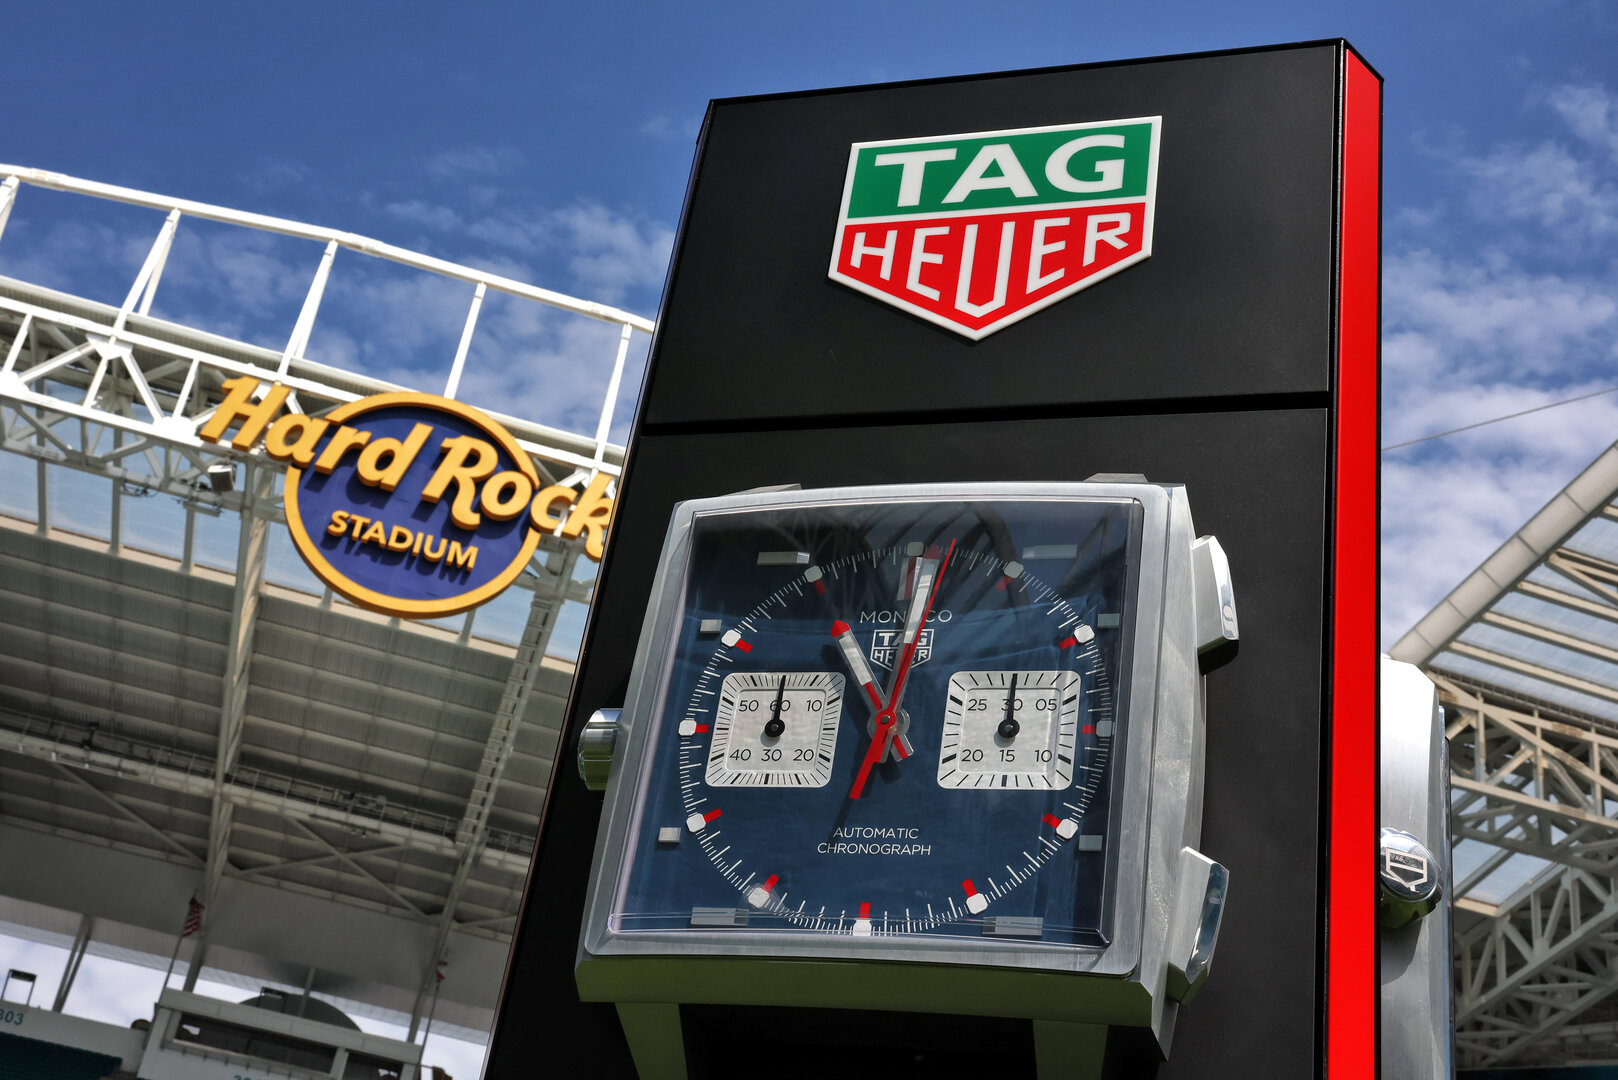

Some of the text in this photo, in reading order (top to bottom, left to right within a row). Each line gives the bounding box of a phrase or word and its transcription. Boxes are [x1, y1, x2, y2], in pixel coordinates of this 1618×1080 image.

[874, 134, 1126, 208] TAG
[850, 212, 1132, 319] HEUER
[200, 375, 615, 563] Hard Rock
[327, 509, 479, 573] STADIUM
[860, 609, 953, 624] MONCO
[873, 649, 928, 668] HER
[738, 699, 823, 713] 50 60 10
[967, 698, 1058, 712] 25 30 05
[729, 748, 815, 762] 40 30 20
[961, 748, 1053, 763] 20 15 10
[832, 827, 920, 840] AUTOMATIC
[817, 842, 932, 856] CHRONOGRAPH
